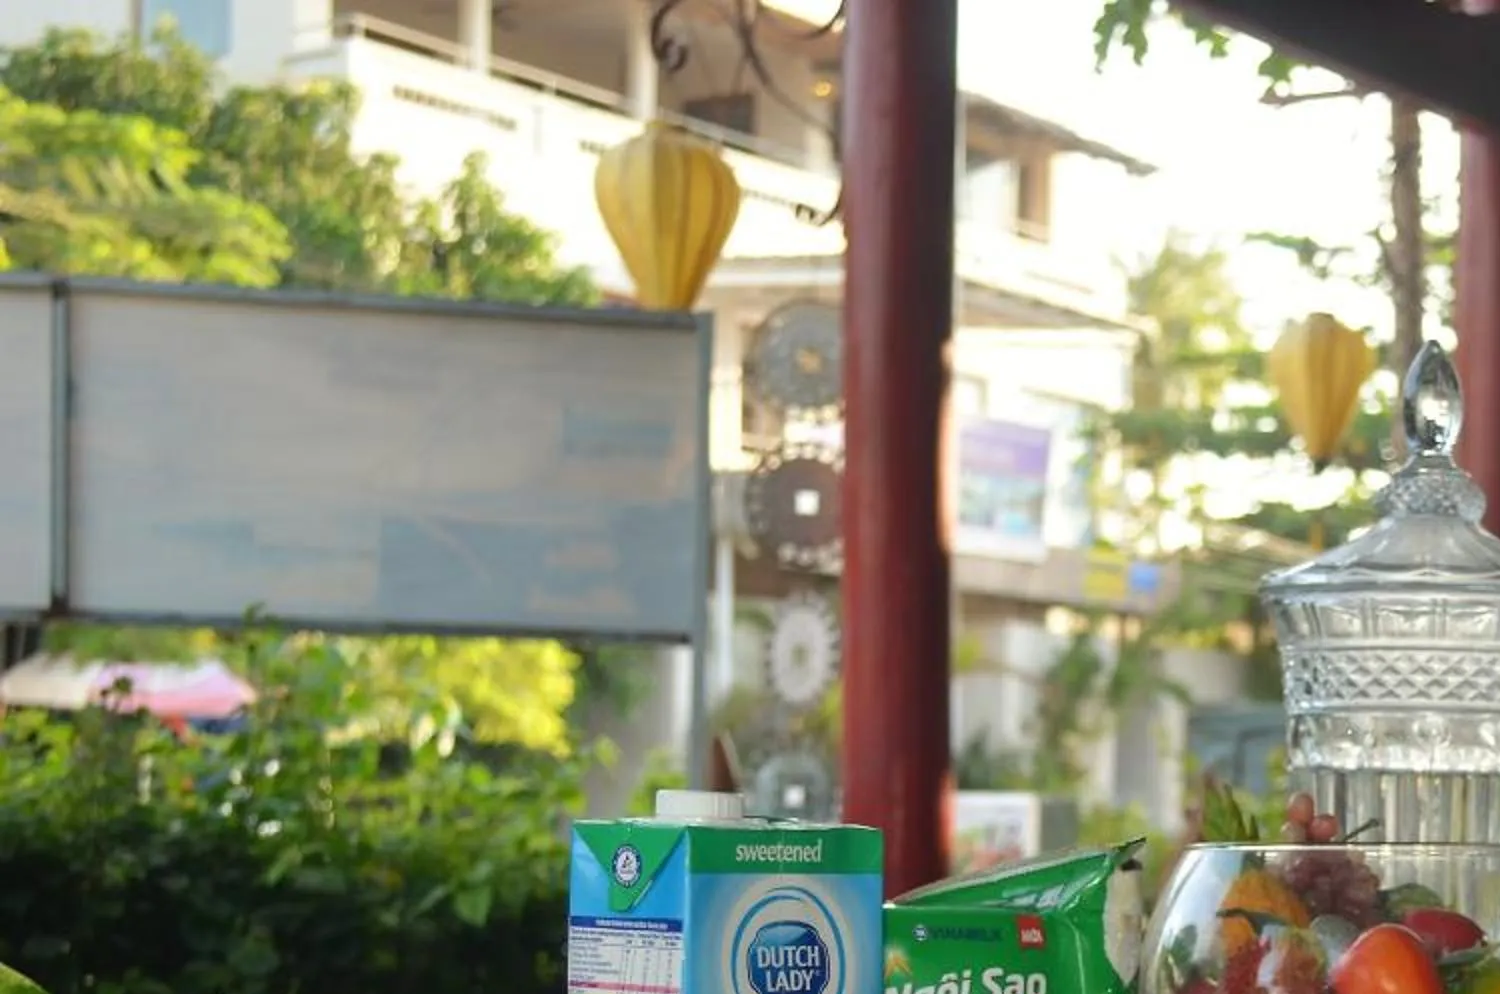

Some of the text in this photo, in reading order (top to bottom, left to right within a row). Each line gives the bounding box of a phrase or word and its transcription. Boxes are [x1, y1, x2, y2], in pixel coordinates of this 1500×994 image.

[736, 839, 822, 862] sweetened
[756, 945, 820, 968] DUTCH
[765, 970, 815, 994] LADY
